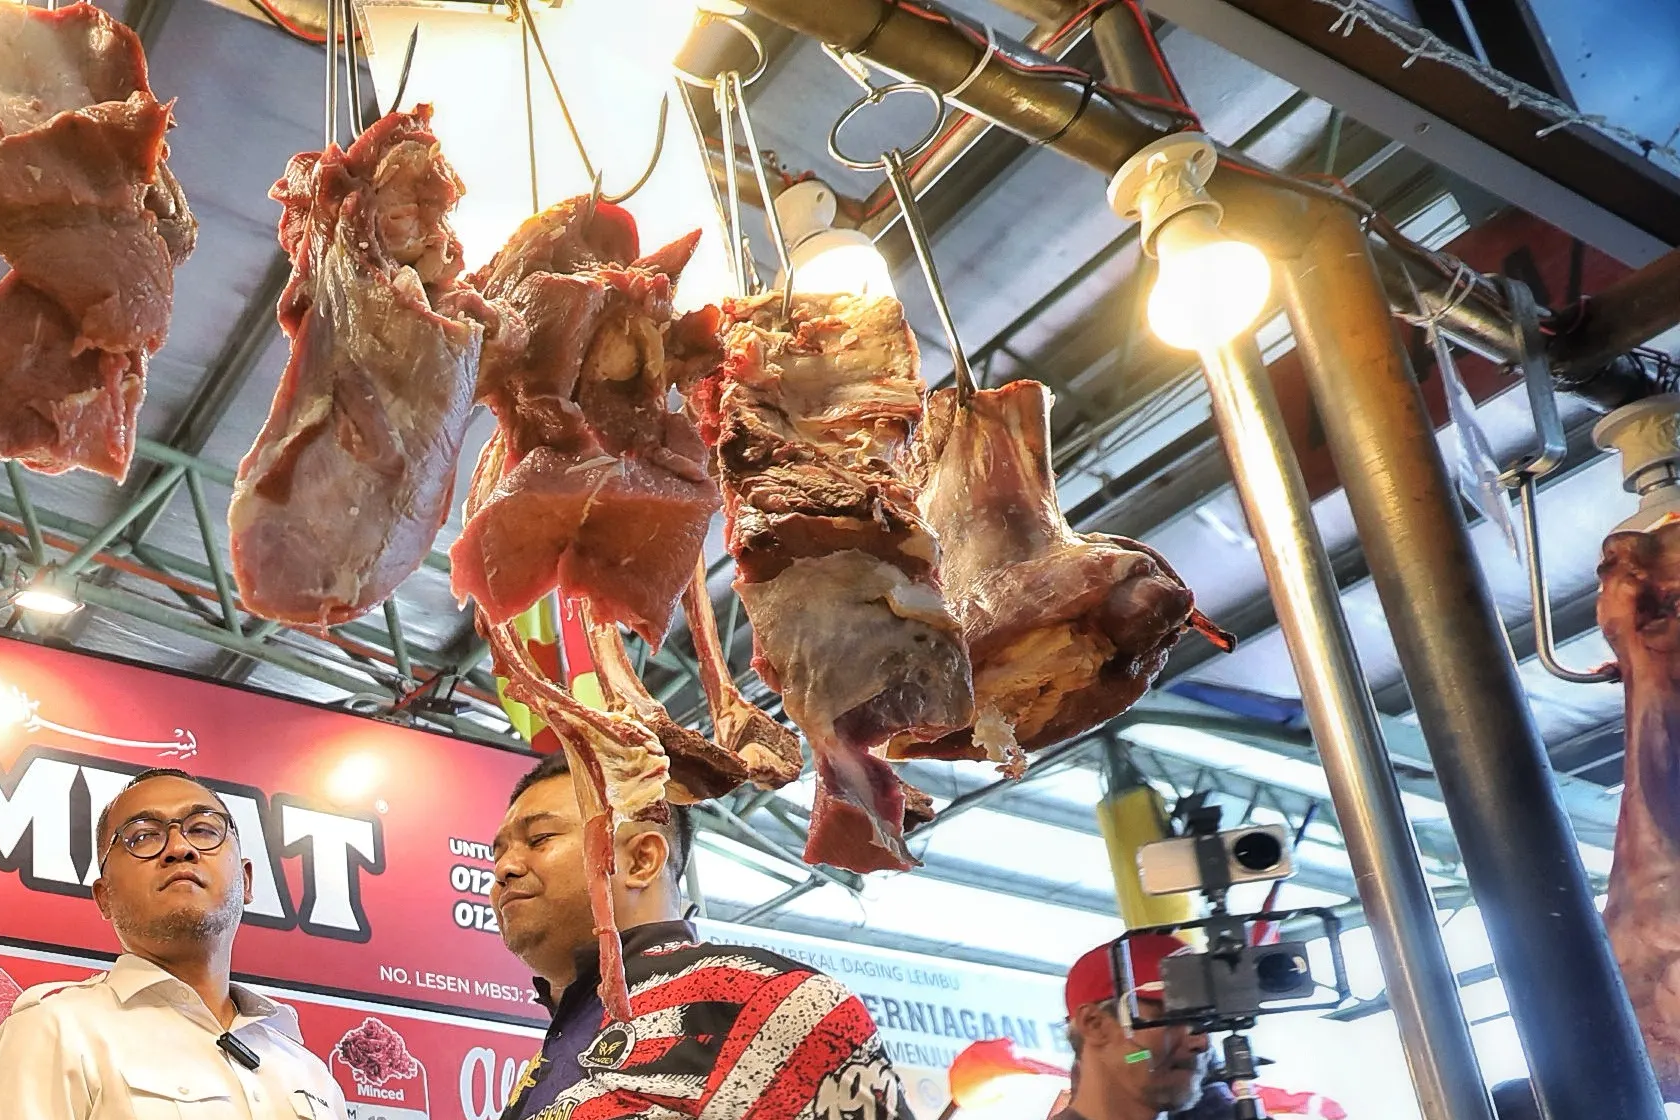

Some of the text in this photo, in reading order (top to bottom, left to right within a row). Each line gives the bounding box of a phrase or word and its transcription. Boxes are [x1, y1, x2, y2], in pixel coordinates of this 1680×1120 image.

[451, 866, 496, 896] 012
[455, 902, 501, 932] 012
[379, 965, 412, 985] NO.
[415, 970, 470, 994] LESEN
[474, 980, 524, 1004] MBSJ:
[841, 960, 905, 982] DAGING
[908, 969, 960, 991] LEMBU
[356, 1083, 405, 1102] Minced
